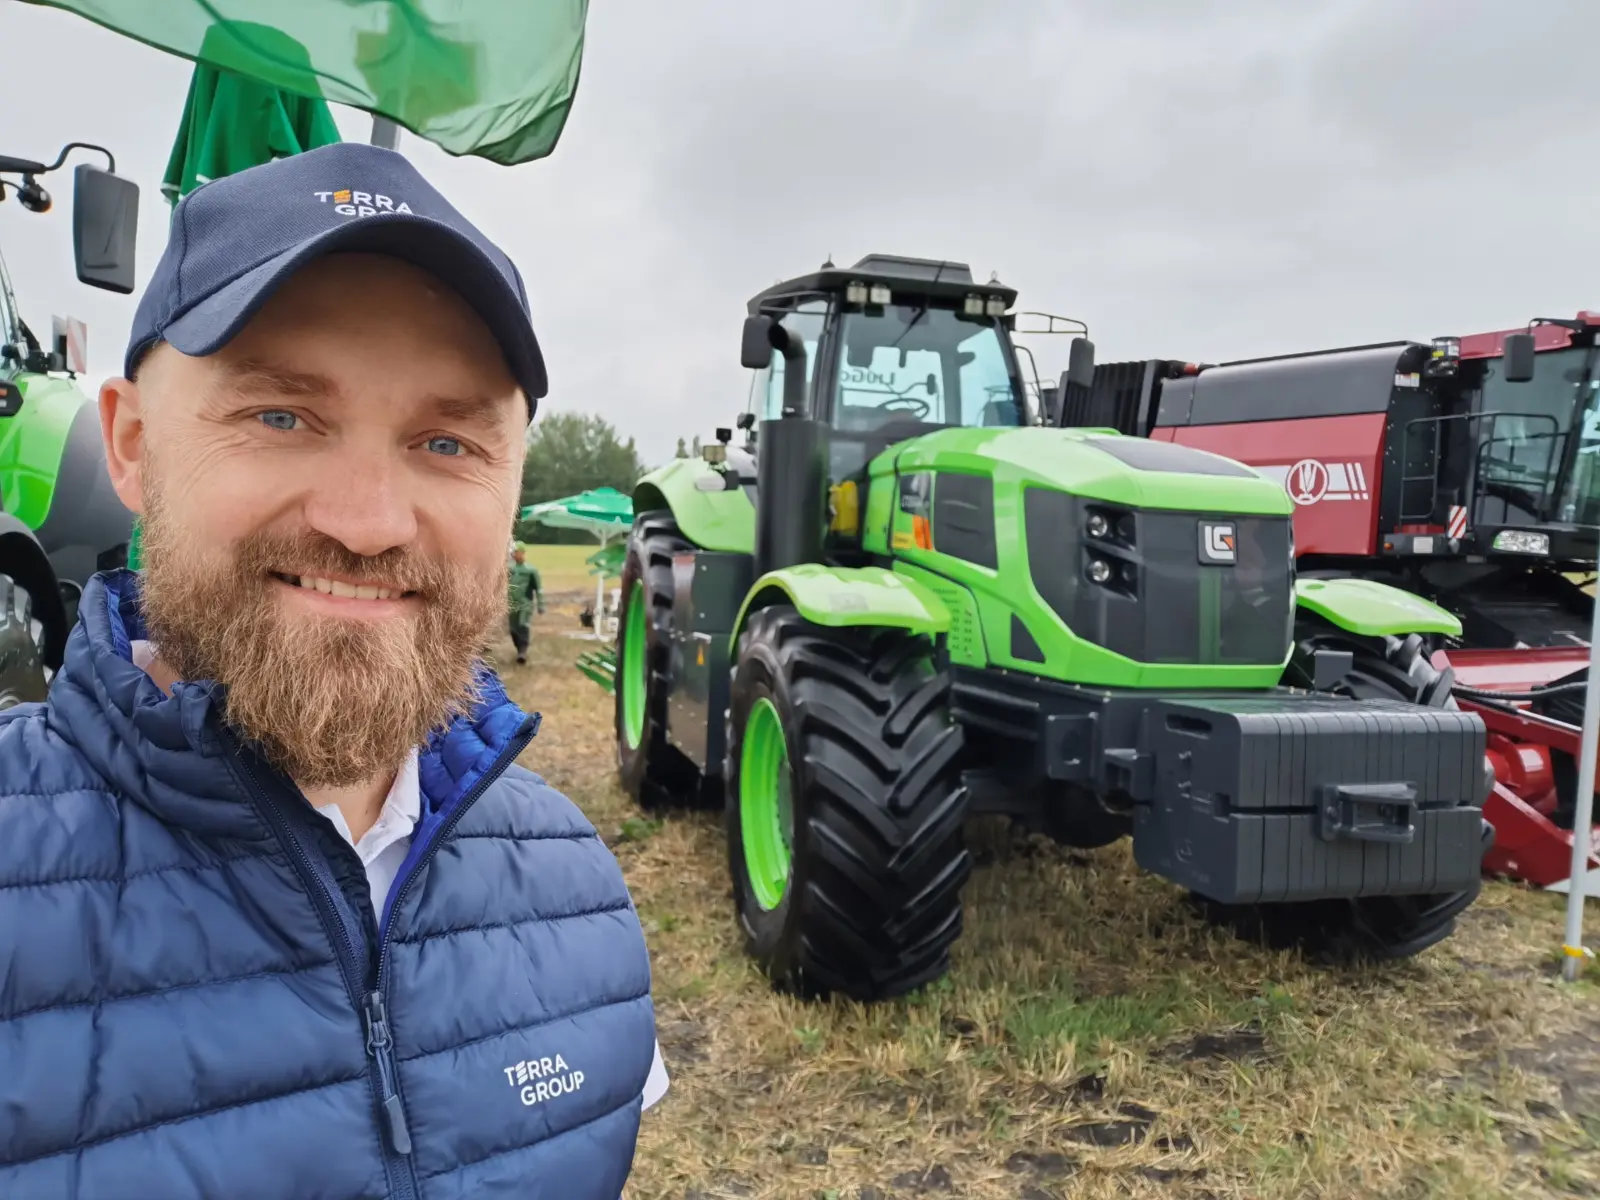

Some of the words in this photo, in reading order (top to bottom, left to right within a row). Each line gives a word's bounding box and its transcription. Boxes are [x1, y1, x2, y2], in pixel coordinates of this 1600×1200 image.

[314, 189, 413, 215] TERRA
[503, 1053, 569, 1087] TERRA
[520, 1070, 585, 1106] GROUP
